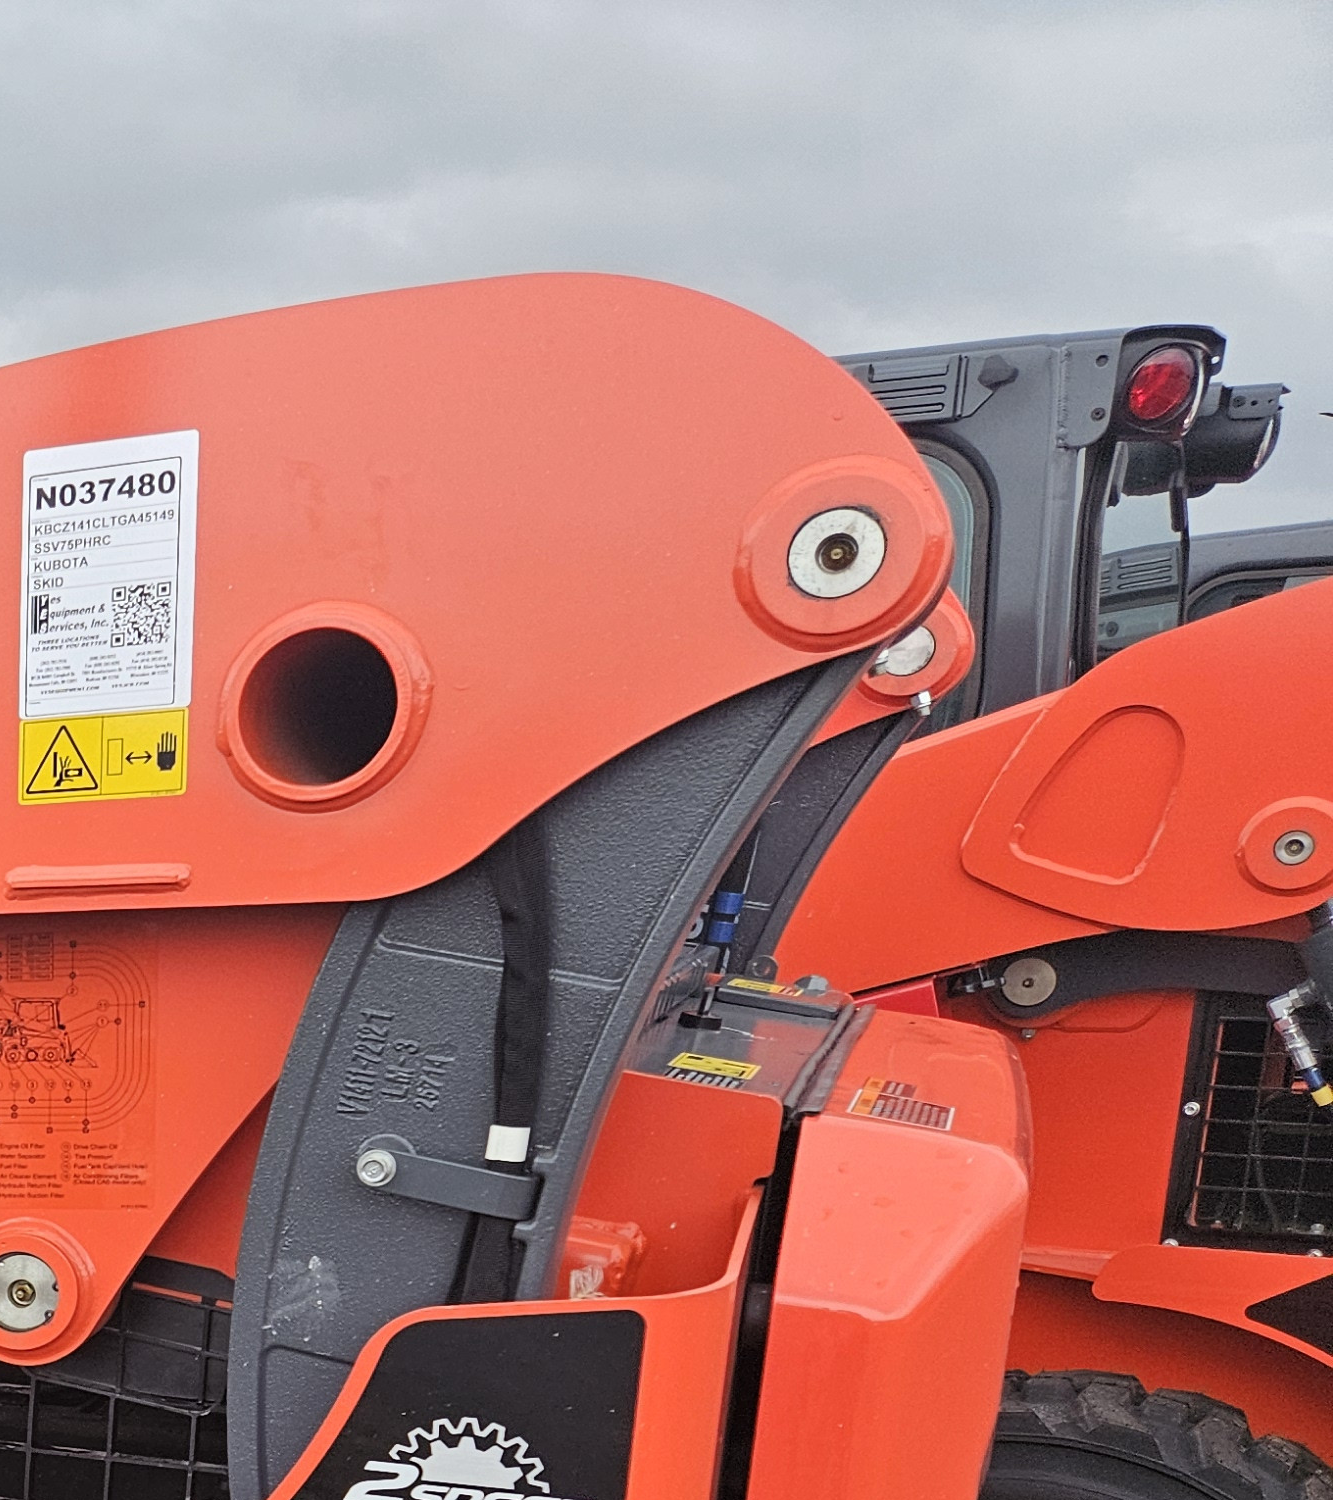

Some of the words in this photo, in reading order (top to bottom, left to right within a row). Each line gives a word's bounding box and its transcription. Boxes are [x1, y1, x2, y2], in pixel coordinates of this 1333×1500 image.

[35, 470, 176, 511] N037480
[34, 535, 111, 554] SSV75PHRC
[34, 556, 88, 573] KUBOTA
[33, 577, 64, 590] SKID
